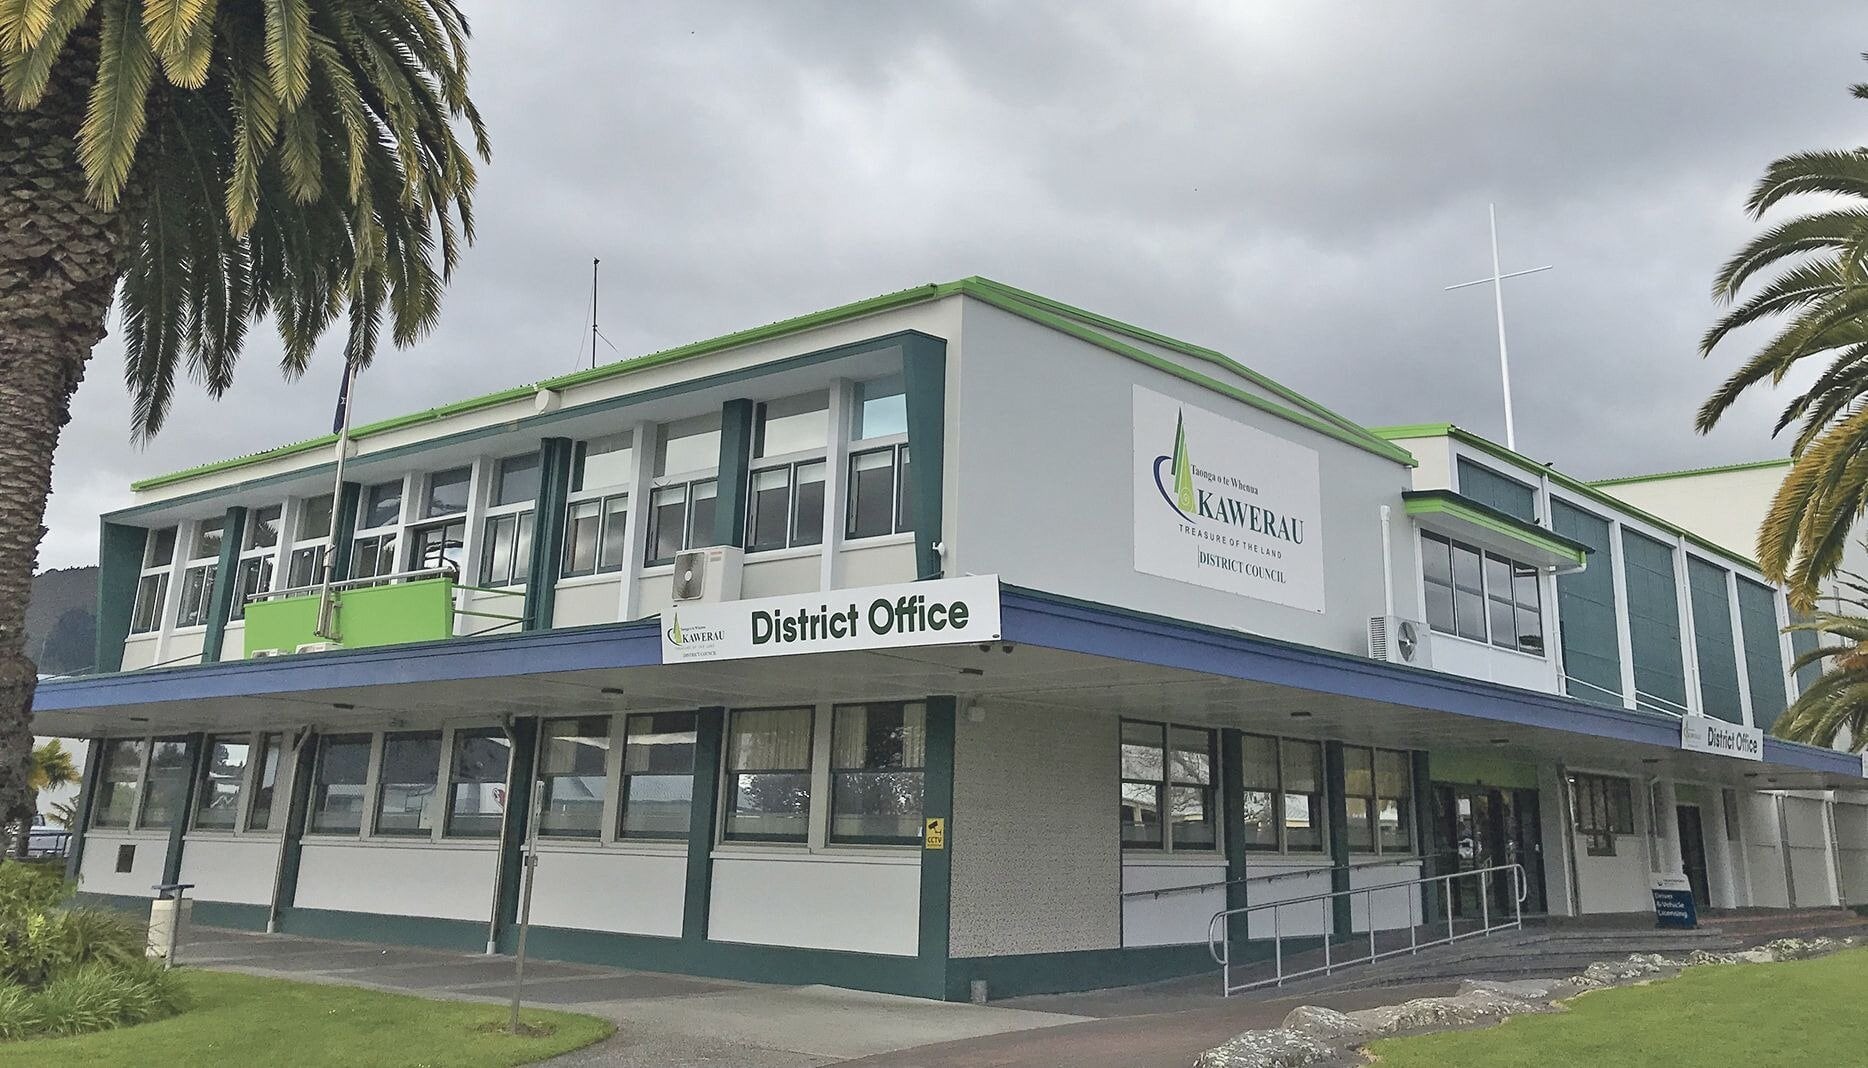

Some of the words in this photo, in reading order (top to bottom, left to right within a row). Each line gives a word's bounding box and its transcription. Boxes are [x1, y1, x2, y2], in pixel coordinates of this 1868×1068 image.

[1191, 464, 1216, 482] Taonga
[1217, 476, 1222, 484] o
[1223, 476, 1230, 486] te
[1231, 478, 1259, 495] Whenua
[1197, 488, 1304, 545] KAWERAU
[1179, 524, 1227, 544] TREASURE
[1229, 538, 1240, 547] OF
[1243, 541, 1259, 553] THE
[1260, 546, 1282, 559] LAND
[1199, 551, 1243, 574] DISTRICT
[1245, 564, 1287, 584] COUNCIL
[751, 603, 859, 645] District
[868, 595, 969, 635] Office
[682, 630, 725, 643] KAWERAU
[1708, 726, 1735, 750] District
[1736, 732, 1758, 753] Office
[927, 836, 942, 844] CCTV
[1658, 910, 1688, 919] Licensing
